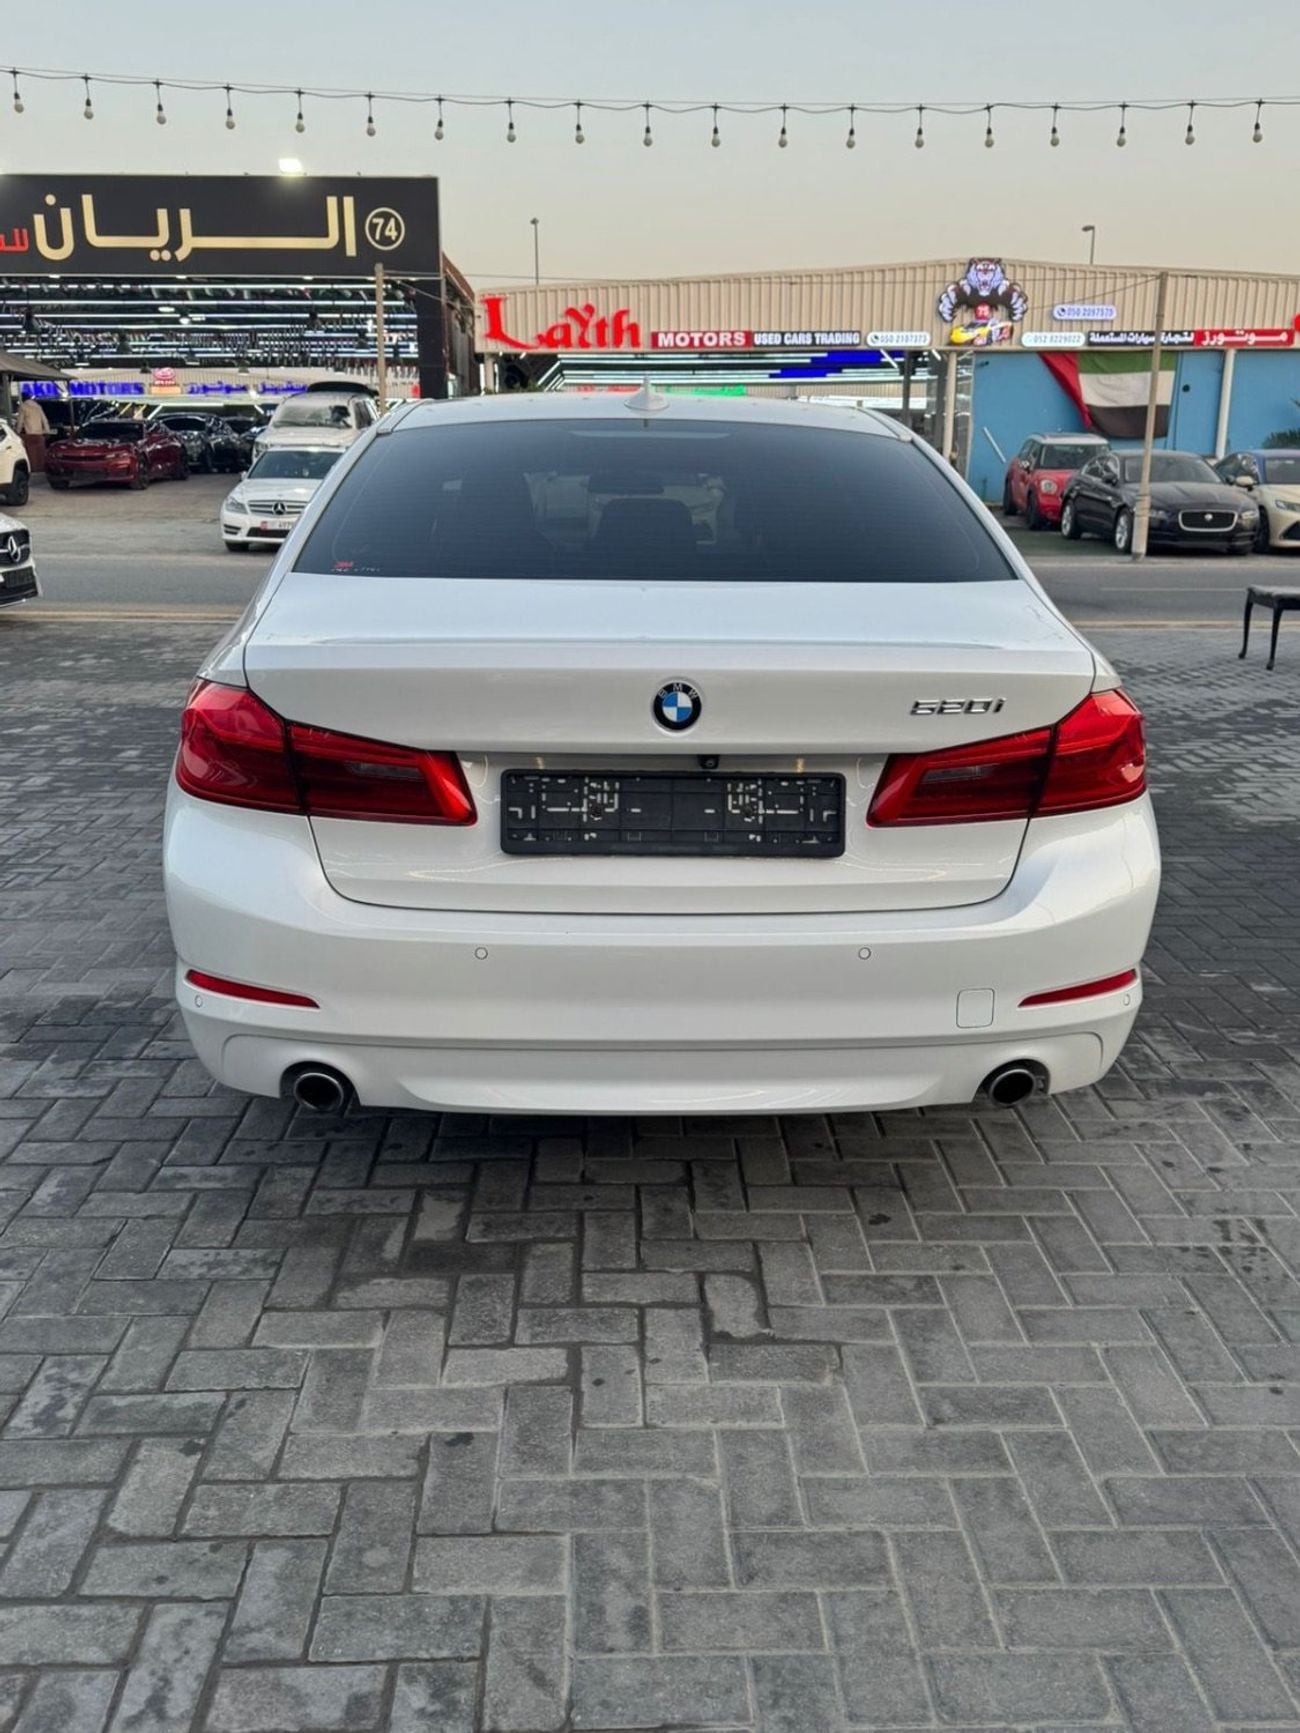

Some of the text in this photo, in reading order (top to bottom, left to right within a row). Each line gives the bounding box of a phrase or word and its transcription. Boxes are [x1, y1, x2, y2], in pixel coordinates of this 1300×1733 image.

[33, 193, 357, 262] الريان
[371, 217, 398, 241] 74
[657, 331, 860, 347] MOTORS USED CARS TRADING
[1201, 330, 1288, 346] موتورز
